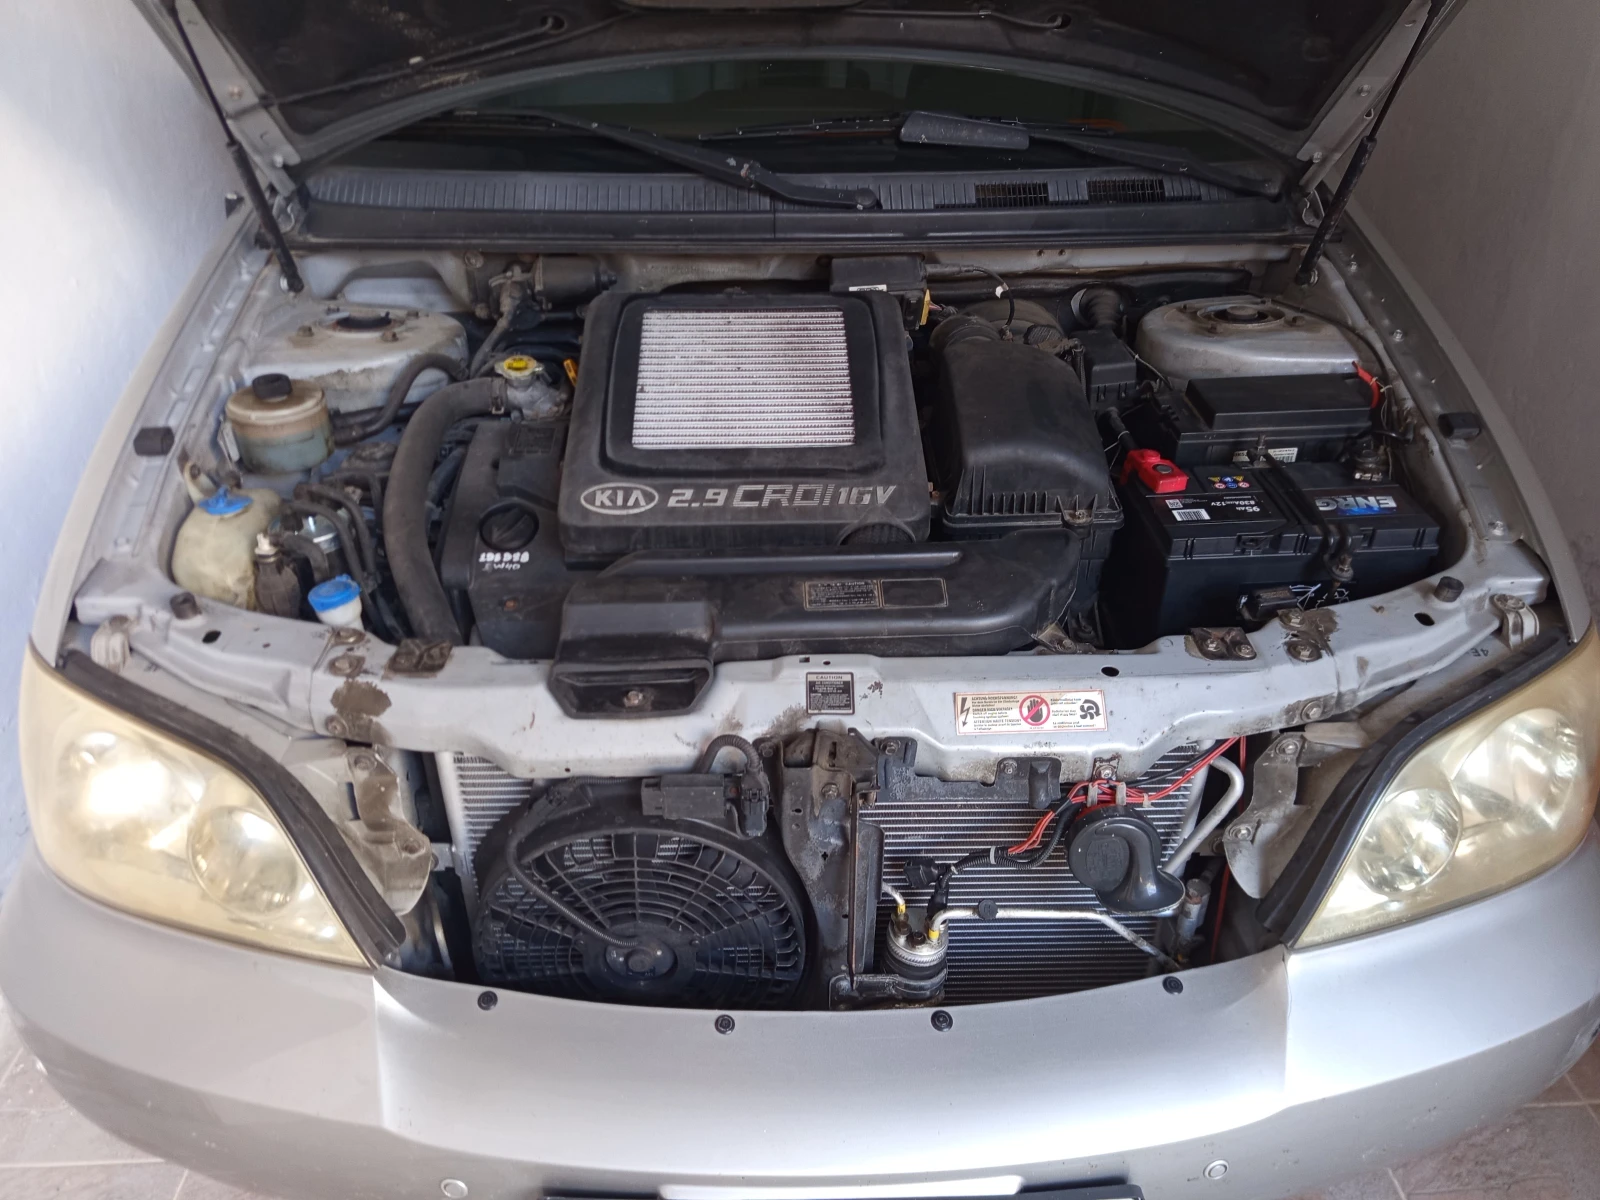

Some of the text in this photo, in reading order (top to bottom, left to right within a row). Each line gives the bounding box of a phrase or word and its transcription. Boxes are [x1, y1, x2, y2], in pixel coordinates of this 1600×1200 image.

[594, 489, 647, 507] KIA
[667, 488, 728, 507] 2.9
[838, 485, 897, 505] 16V
[1315, 496, 1397, 511] ENRG
